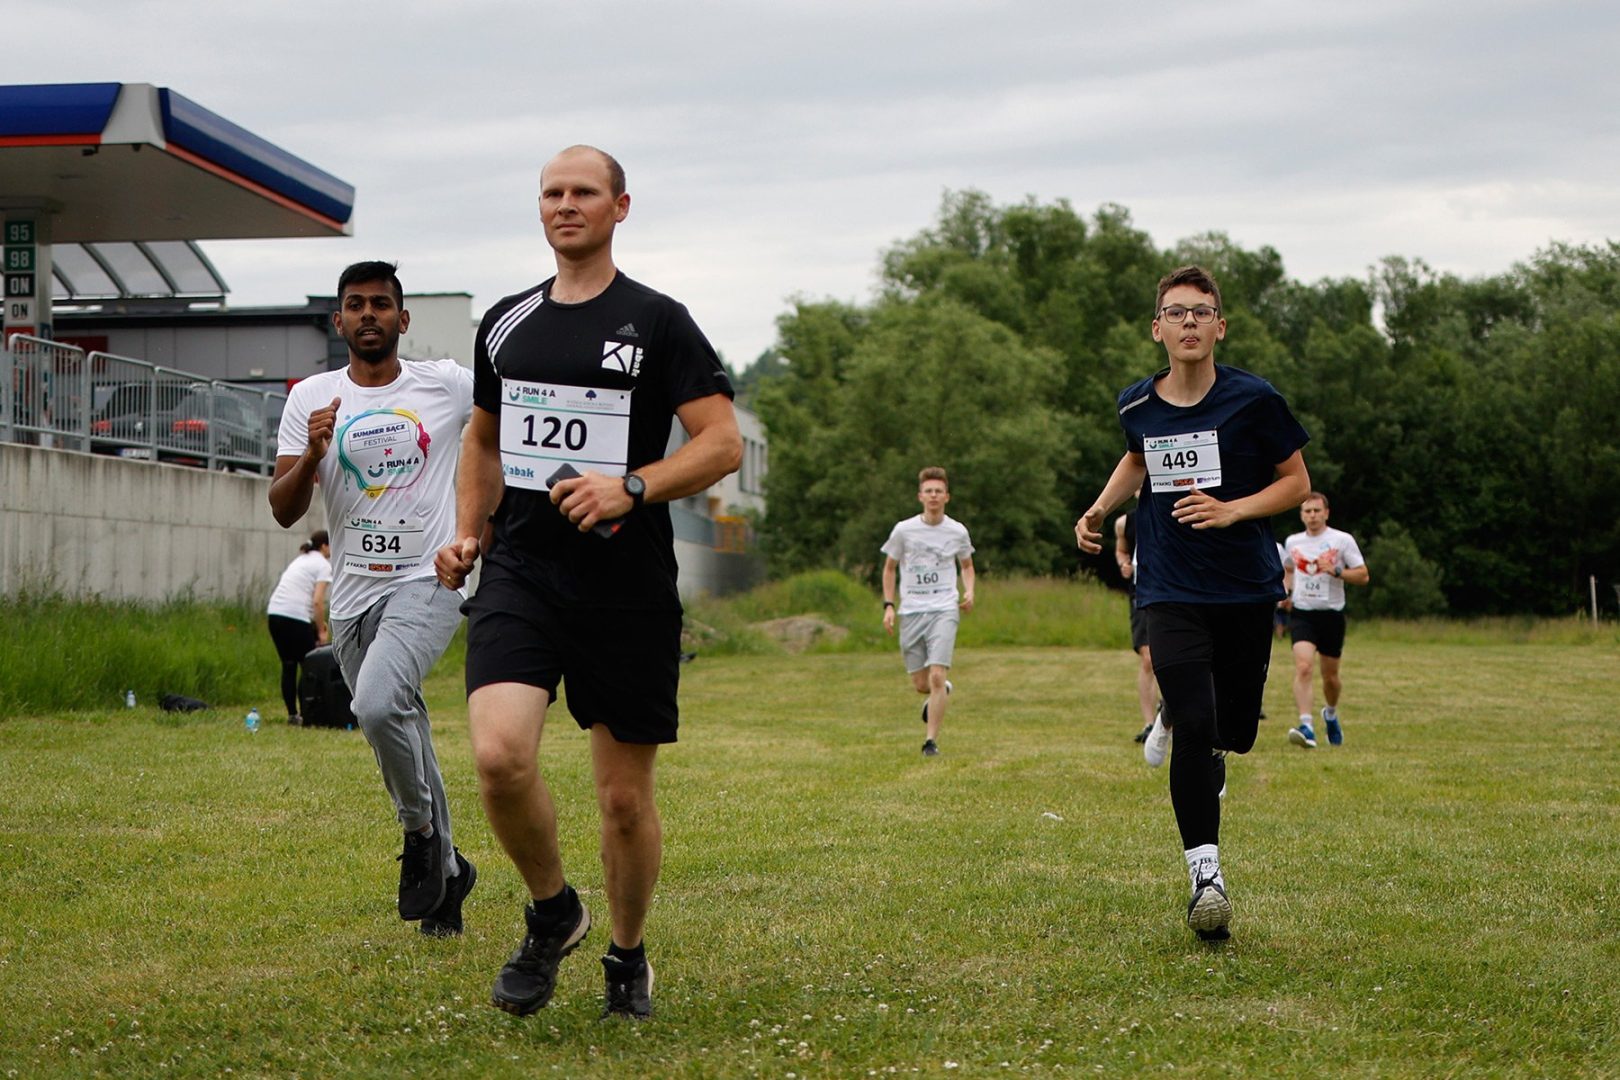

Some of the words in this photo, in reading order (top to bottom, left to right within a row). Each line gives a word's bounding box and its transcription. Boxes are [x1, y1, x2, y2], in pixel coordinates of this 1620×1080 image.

[10, 225, 30, 240] 95
[10, 251, 30, 267] 98
[10, 278, 30, 294] ON
[12, 304, 28, 318] ON
[522, 386, 539, 396] RUN
[549, 390, 556, 398] A
[522, 395, 547, 405] SMILE
[352, 428, 384, 439] SUMMER
[386, 424, 406, 433] SĄCZ
[522, 414, 587, 451] 120
[364, 436, 397, 447] FESTIVAL
[386, 459, 405, 468] RUN
[1162, 450, 1198, 470] 449
[362, 534, 401, 553] 634
[916, 572, 939, 584] 160
